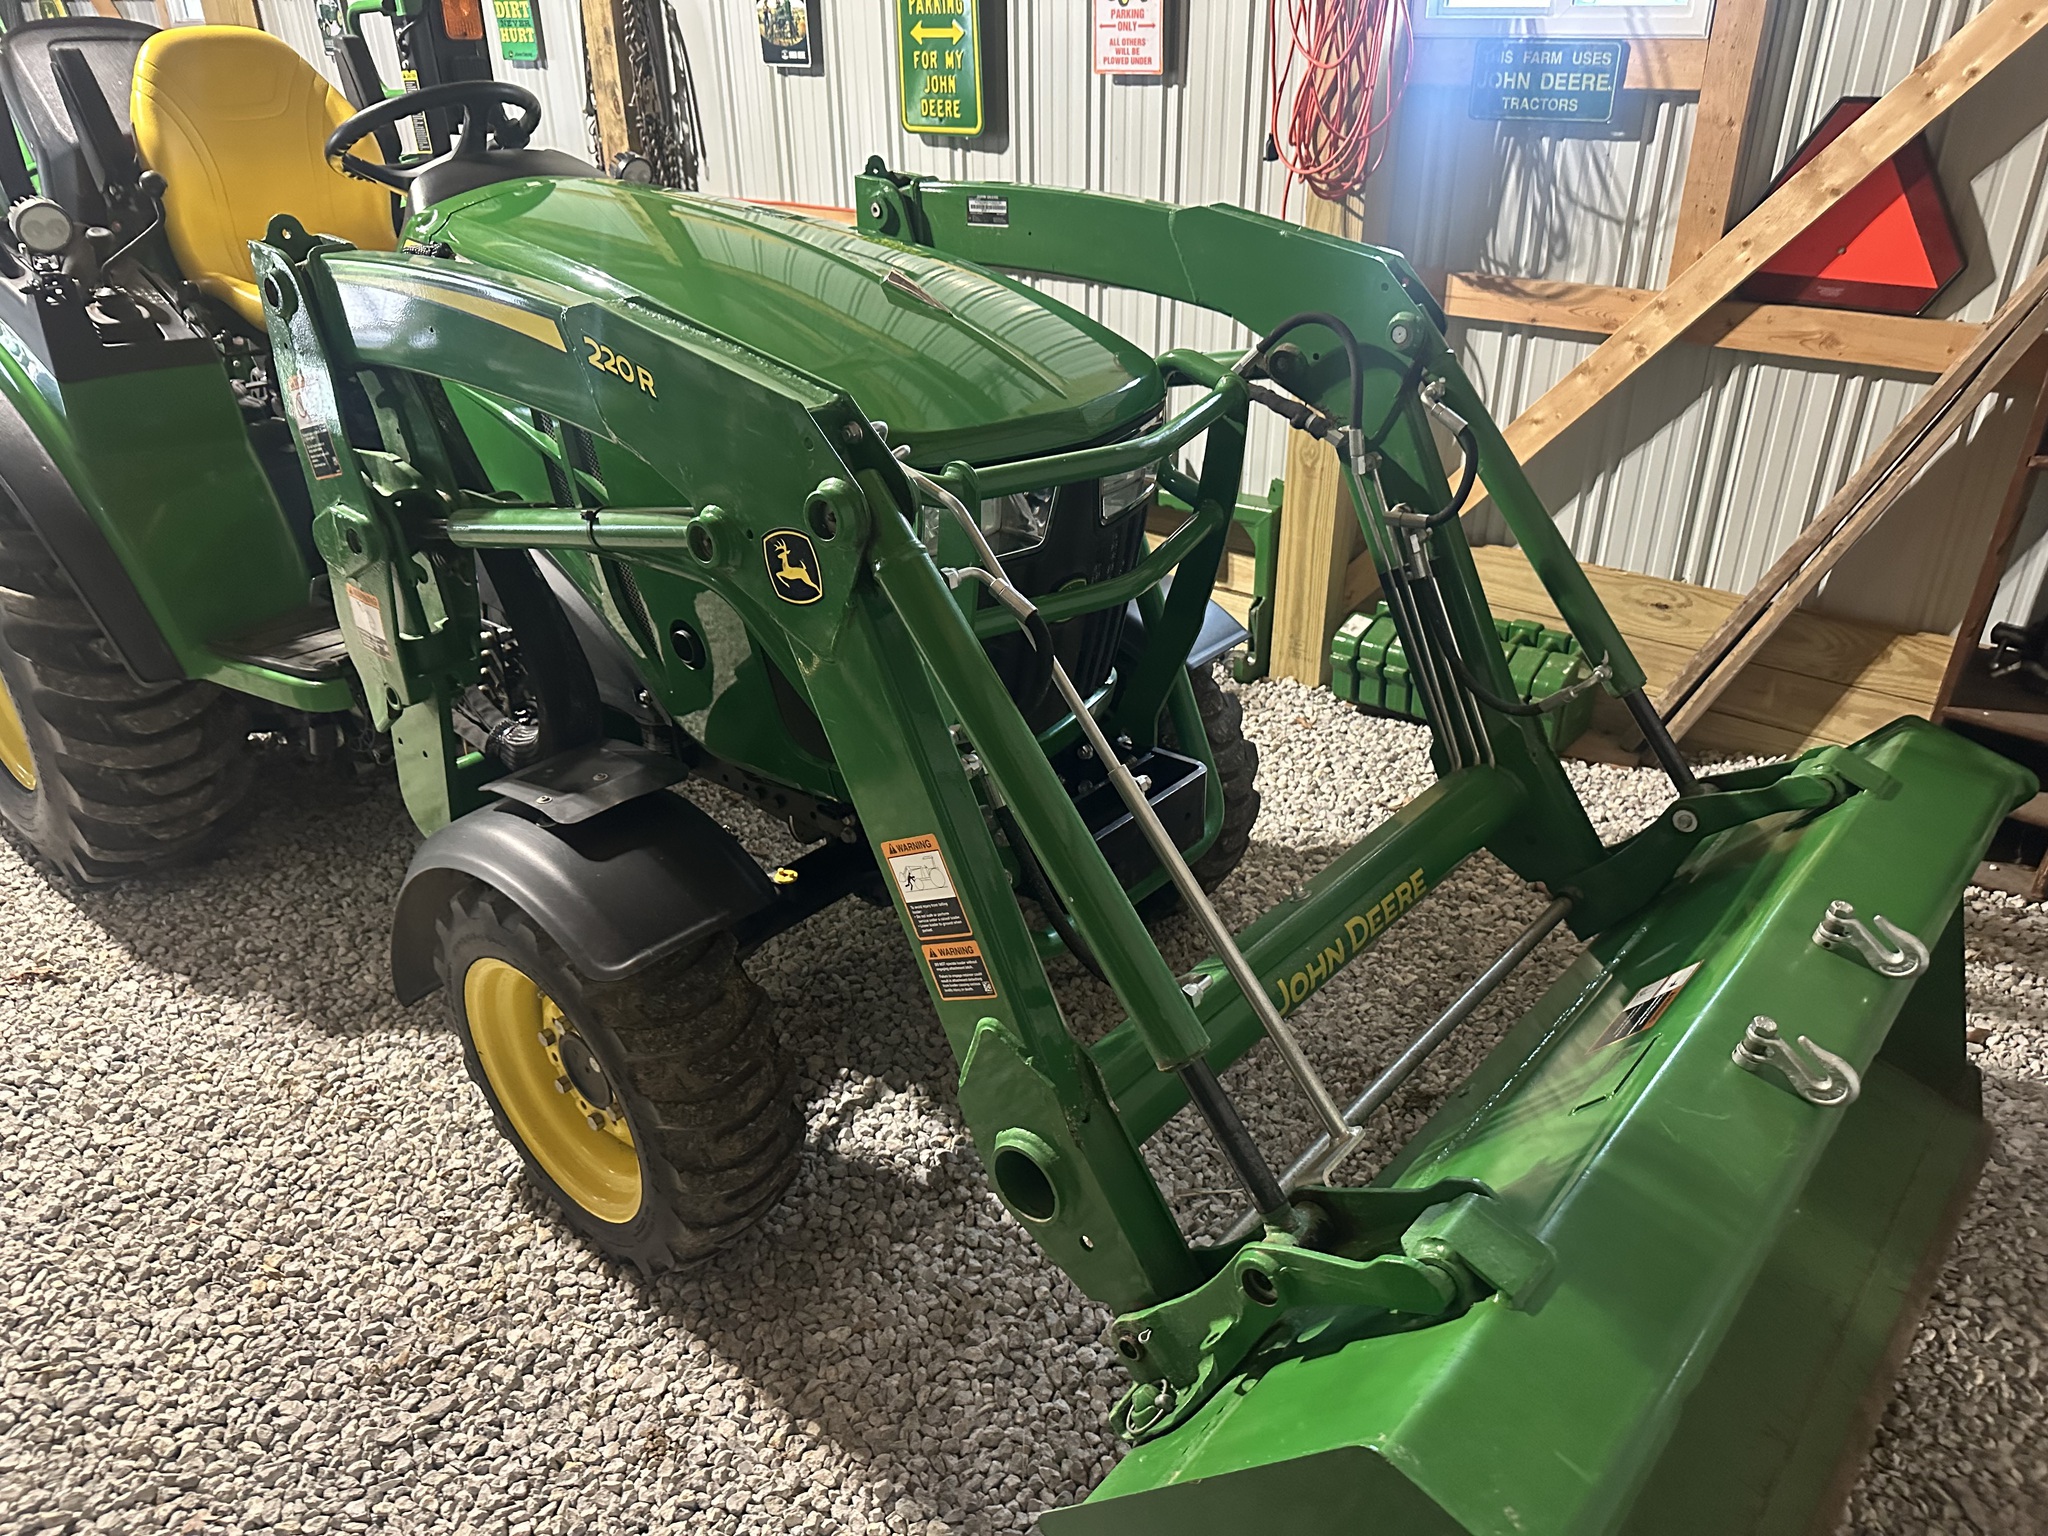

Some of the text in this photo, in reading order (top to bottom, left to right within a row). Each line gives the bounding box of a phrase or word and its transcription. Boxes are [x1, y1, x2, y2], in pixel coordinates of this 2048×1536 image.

[494, 1, 530, 18] DIRT
[908, 0, 964, 15] PARKING
[1111, 9, 1144, 19] PARKING
[1118, 21, 1137, 31] ONLY
[500, 28, 535, 43] HURT
[1109, 38, 1146, 46] ALL OTHERS
[913, 50, 963, 69] FOR MY
[1103, 57, 1152, 65] PLOWED UNDER
[1523, 51, 1562, 64] FARM
[1573, 52, 1612, 65] USES
[924, 75, 956, 93] JOHN
[1477, 71, 1531, 89] JOHN
[921, 99, 961, 118] DEERE
[1502, 96, 1578, 112] TRACTORS
[896, 839, 932, 853] WARNING
[1277, 868, 1427, 1017] JOHN DEERE
[938, 945, 974, 956] WARNING
